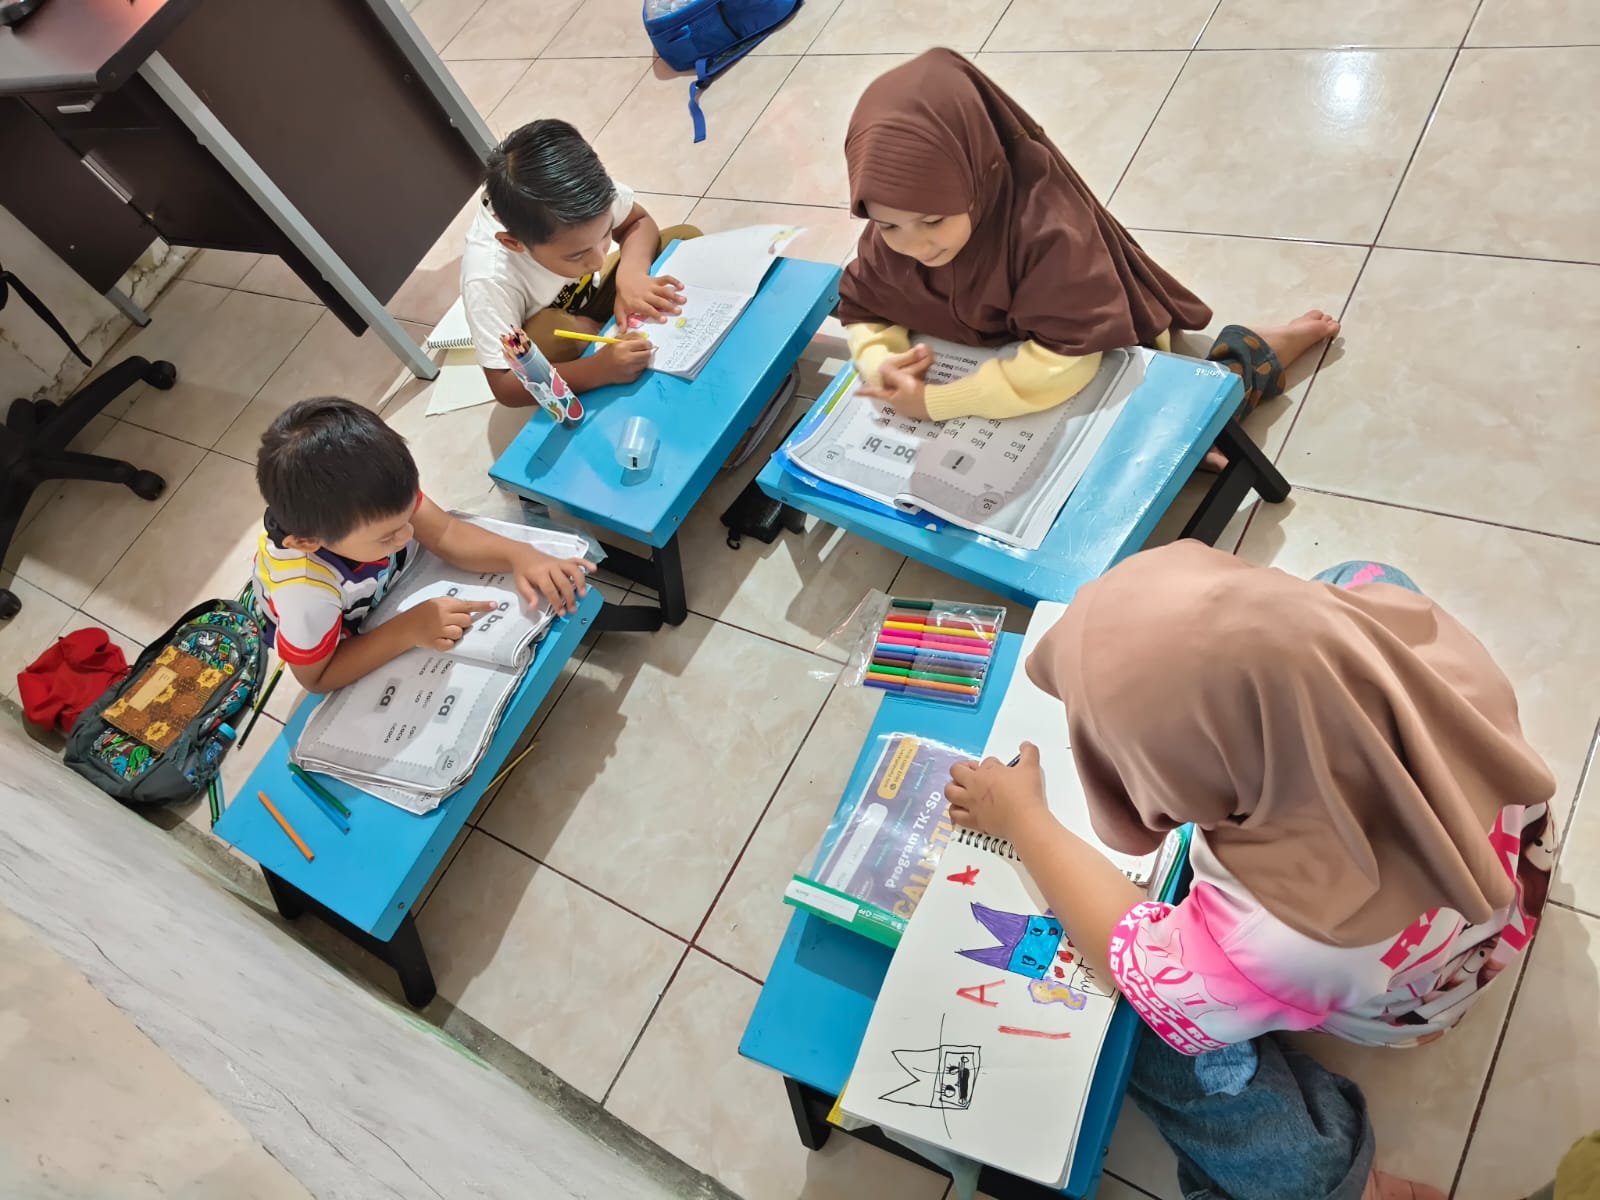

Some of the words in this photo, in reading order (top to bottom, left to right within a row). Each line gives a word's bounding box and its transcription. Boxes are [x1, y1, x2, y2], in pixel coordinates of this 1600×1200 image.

[862, 436, 882, 453] bi
[893, 445, 917, 464] ba
[1010, 441, 1026, 452] ika
[1003, 451, 1019, 463] ica
[379, 685, 397, 707] ca
[437, 694, 456, 717] ca
[884, 832, 921, 889] Program
[912, 791, 942, 831] TK-SD
[955, 979, 1006, 1008] A
